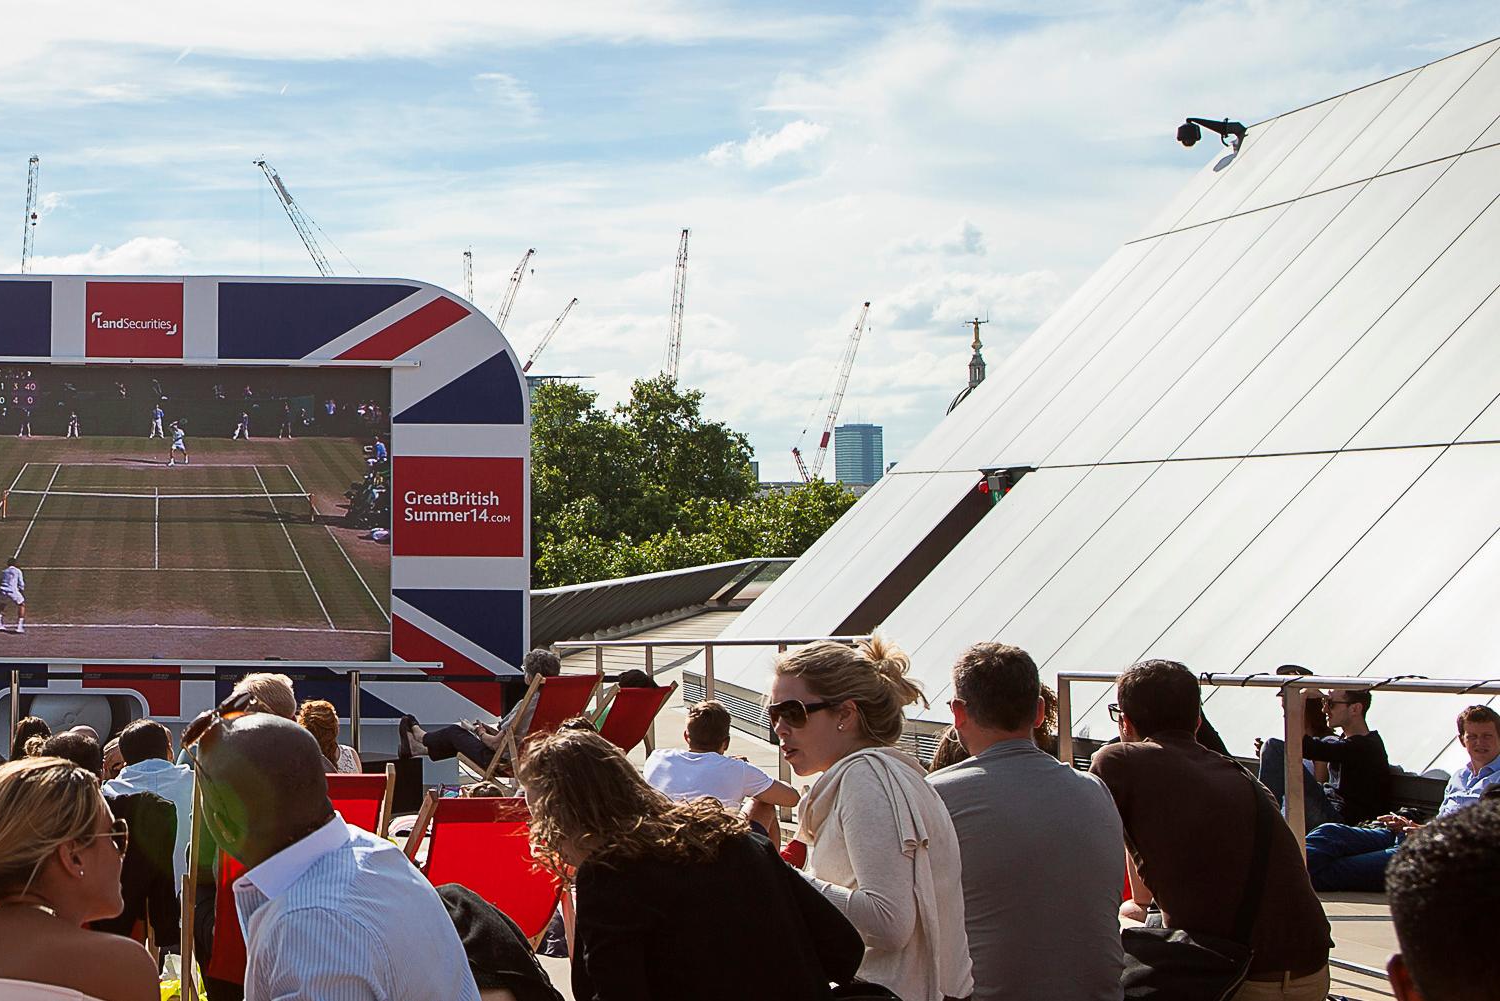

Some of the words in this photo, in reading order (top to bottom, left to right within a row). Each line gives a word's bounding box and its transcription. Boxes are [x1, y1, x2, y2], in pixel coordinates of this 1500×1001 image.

[96, 317, 172, 330] LandSecurities
[13, 382, 19, 390] 3
[24, 382, 37, 391] 40
[0, 396, 5, 404] 0
[12, 396, 19, 404] 4
[27, 396, 34, 404] 0
[404, 490, 499, 506] GreatBritish
